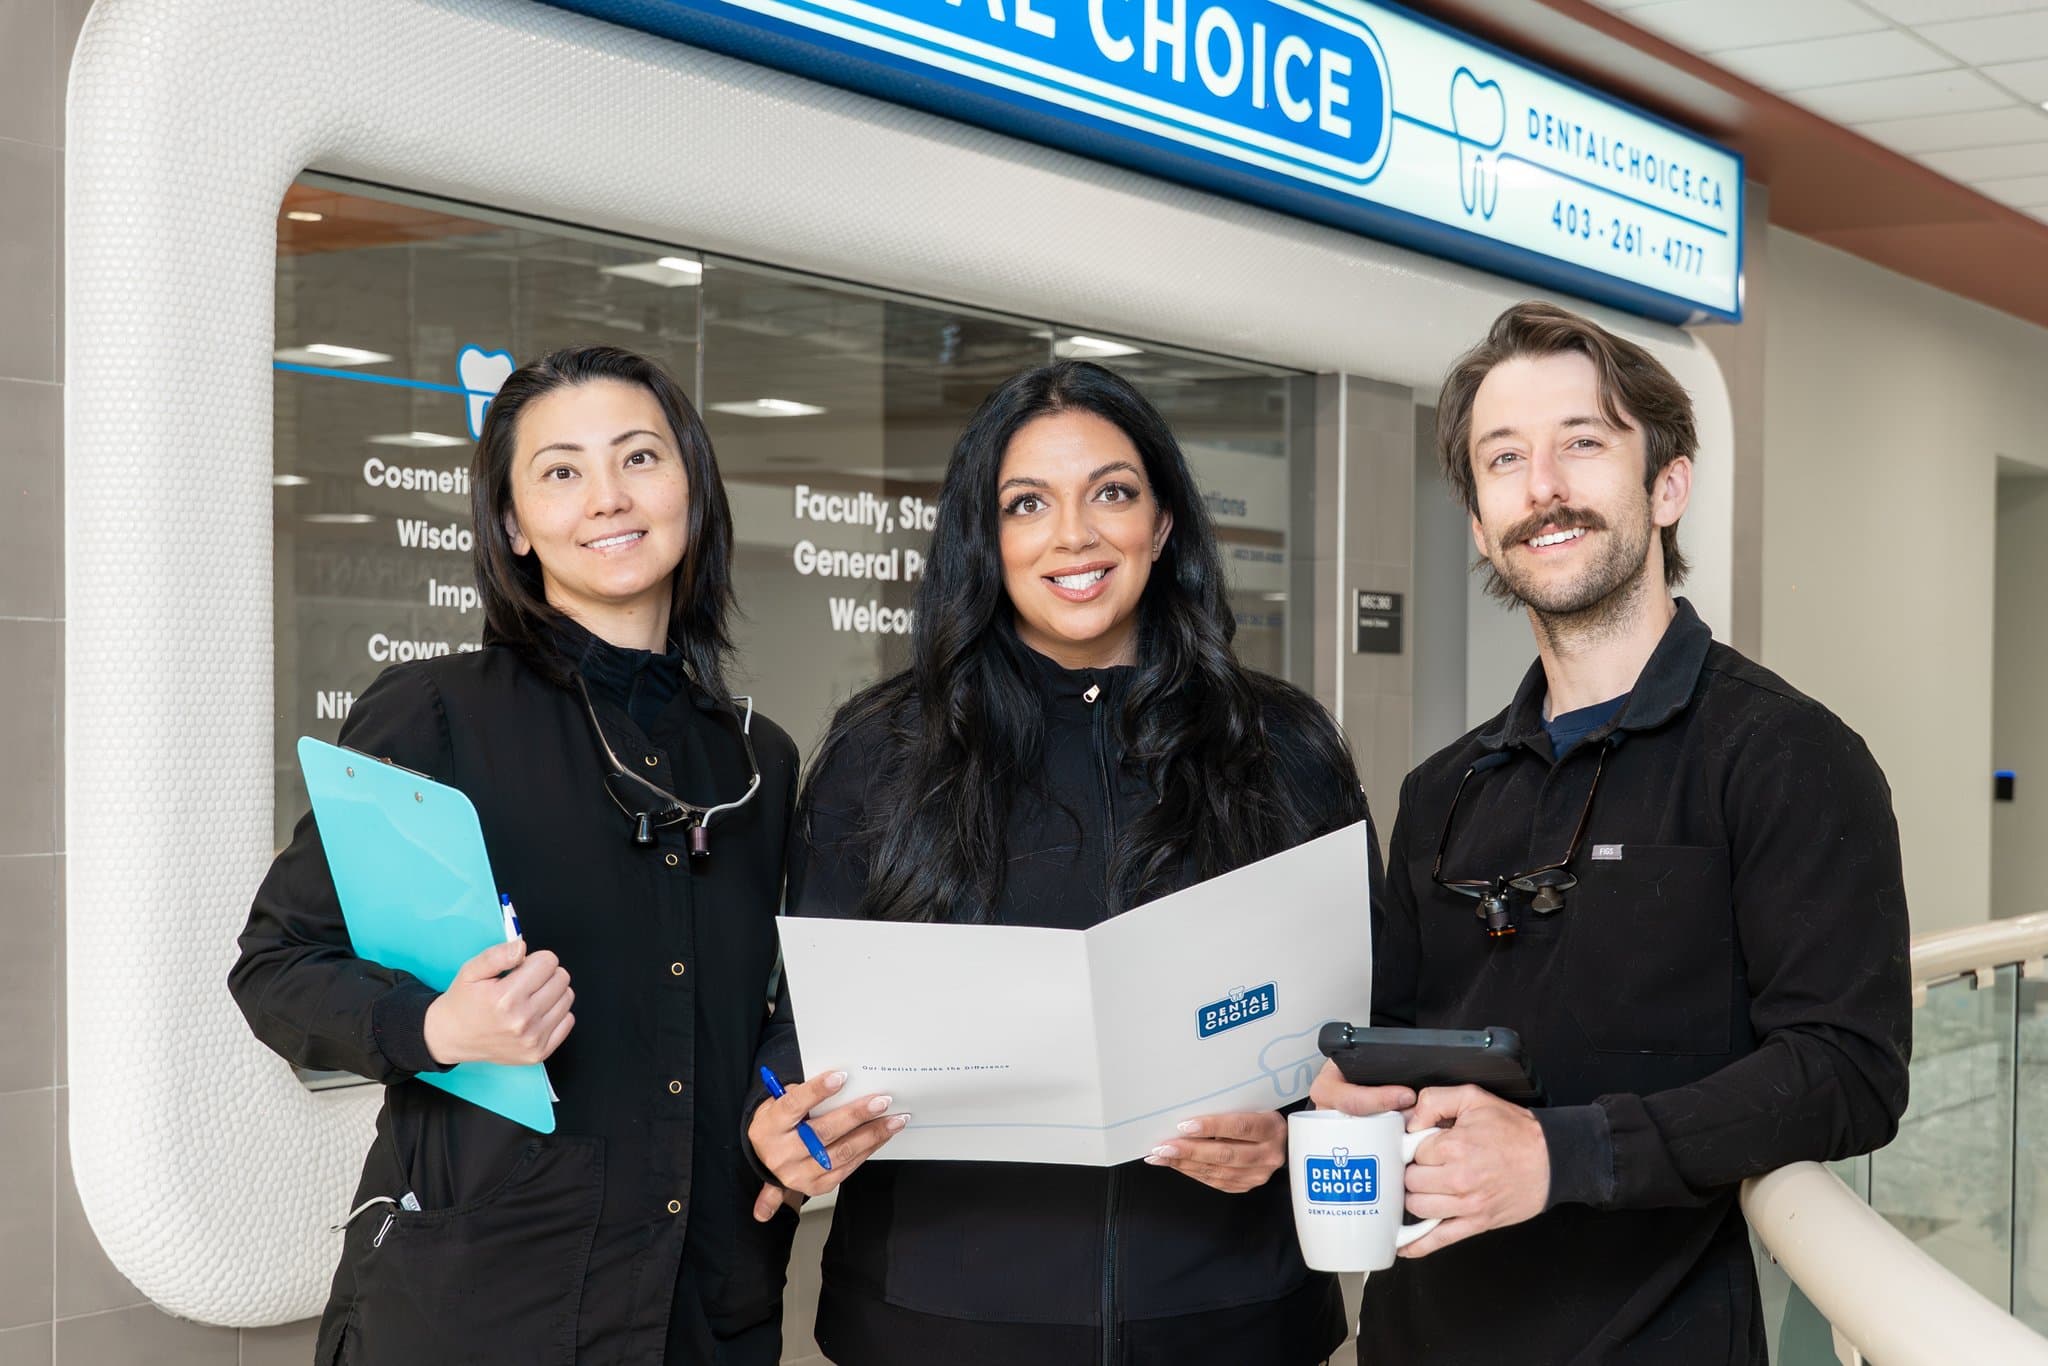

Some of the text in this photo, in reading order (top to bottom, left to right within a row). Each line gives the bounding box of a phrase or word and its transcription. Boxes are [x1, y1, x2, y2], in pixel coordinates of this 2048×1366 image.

[1088, 0, 1352, 139] CHOICE
[1528, 107, 1723, 211] DENTALCHOICE.CA
[363, 457, 470, 495] Cosmeti
[795, 484, 938, 534] Faculty, Sta
[397, 518, 473, 552] Wisdo
[794, 540, 898, 581] General
[829, 597, 914, 634] Welco
[368, 633, 450, 662] Crown
[317, 690, 357, 719] Nit
[1205, 1001, 1270, 1030] CHOICE
[1206, 993, 1269, 1022] DENTAL
[1311, 1181, 1372, 1194] CHOICE
[1312, 1167, 1372, 1181] DENTAL
